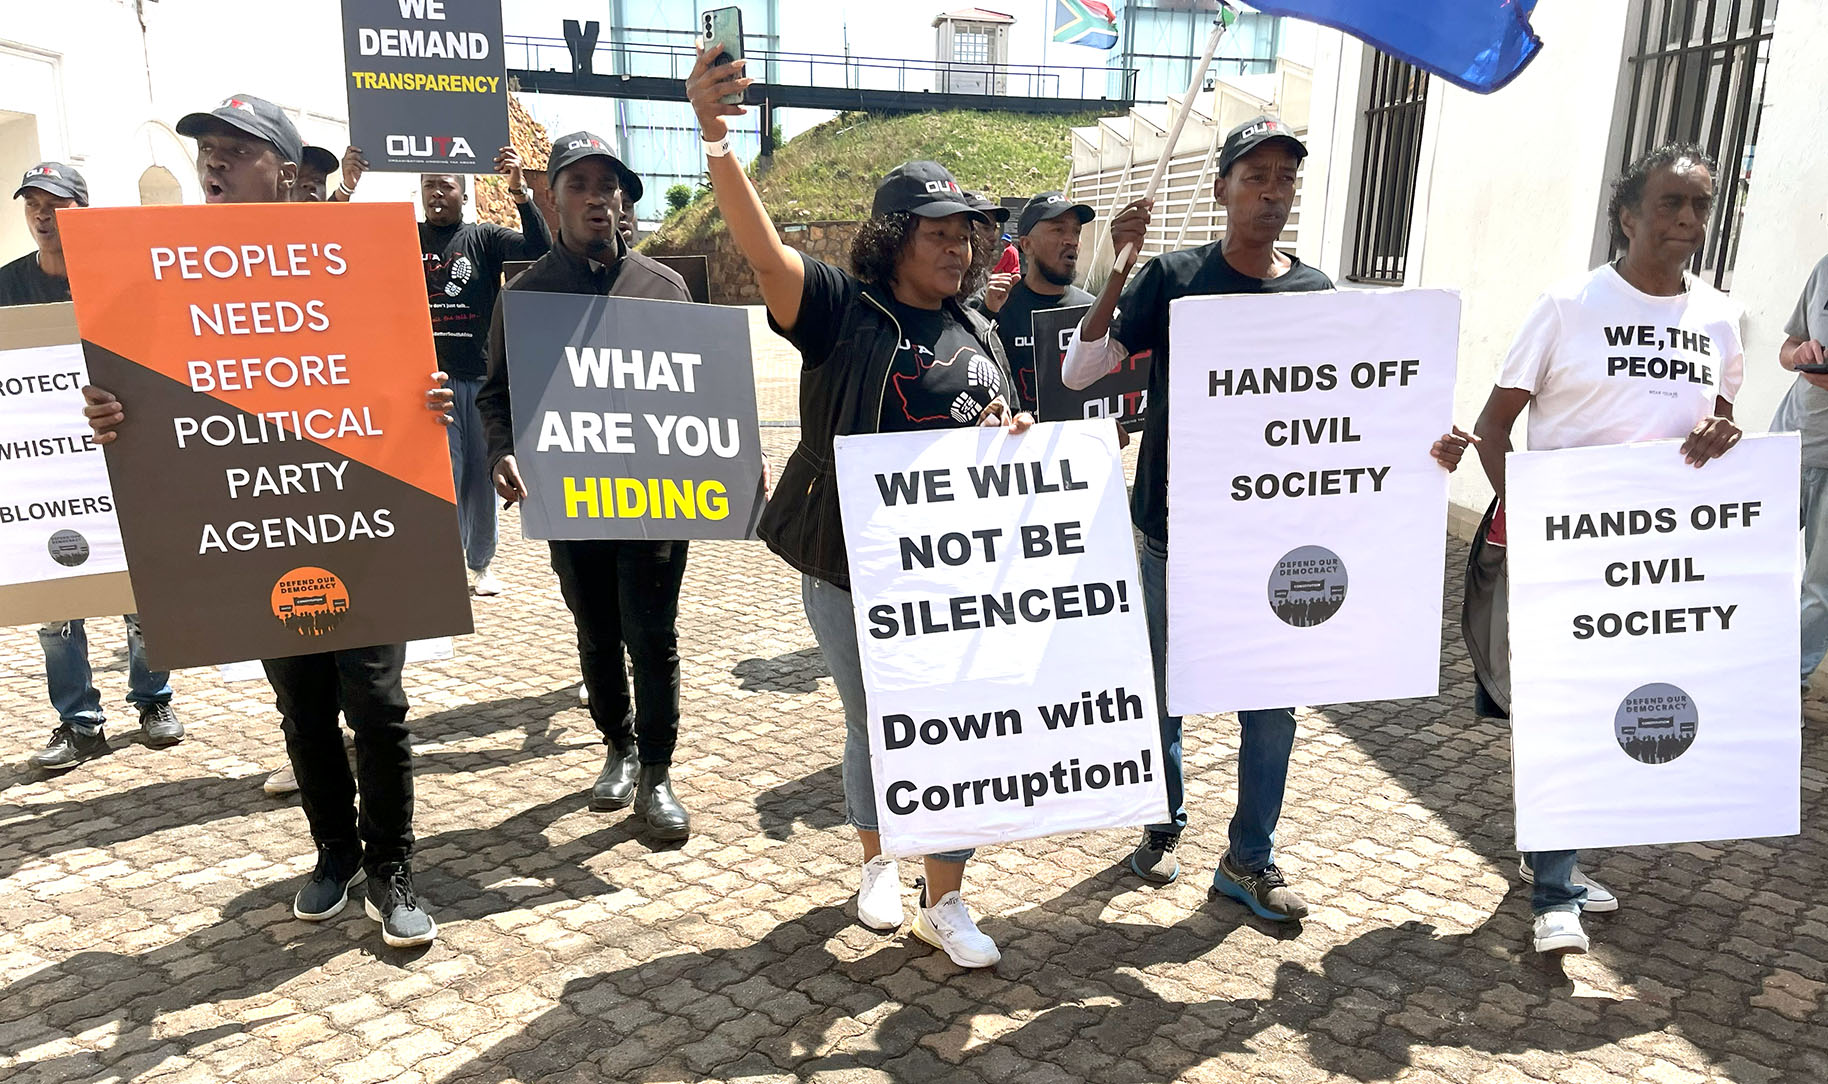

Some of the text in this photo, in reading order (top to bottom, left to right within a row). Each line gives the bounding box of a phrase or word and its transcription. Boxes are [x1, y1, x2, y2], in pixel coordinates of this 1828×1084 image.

[399, 0, 445, 20] WE
[359, 28, 489, 60] DEMAND
[352, 71, 500, 93] TRANSPARENCY
[386, 135, 476, 158] OUTA
[151, 243, 347, 280] PEOPLE'S
[421, 252, 440, 262] UTA
[190, 300, 330, 336] NEEDS
[1014, 336, 1034, 347] OU
[0, 372, 81, 397] OTECT
[188, 354, 350, 392] BEFORE
[565, 346, 702, 393] WHAT
[1209, 360, 1420, 397] HANDS OFF
[1607, 357, 1714, 386] PEOPLE
[173, 406, 383, 449] POLITICAL
[537, 411, 740, 458] ARE YOU
[1264, 417, 1361, 447] CIVIL
[226, 461, 349, 499] PARTY
[875, 459, 1088, 507] WE WILL
[1231, 466, 1391, 501] SOCIETY
[0, 495, 113, 524] BLOWERS
[563, 477, 730, 521] HIDING
[199, 508, 395, 555] AGENDAS
[1545, 501, 1762, 541] HANDS OFF
[899, 521, 1085, 571] NOT BE
[1280, 560, 1316, 568] DEFEND
[1280, 566, 1338, 576] DEMOCRACY
[1605, 557, 1705, 587] CIVIL
[279, 579, 315, 588] DEFEND
[281, 583, 336, 594] DEMOCRACY
[868, 579, 1130, 640] SILENCED!
[1572, 604, 1738, 640] SOCIETY
[882, 686, 1144, 751] Down with
[1626, 697, 1663, 705] DEFEND
[1626, 703, 1687, 713] DEMOCRACY
[886, 749, 1153, 816] Corruption!
